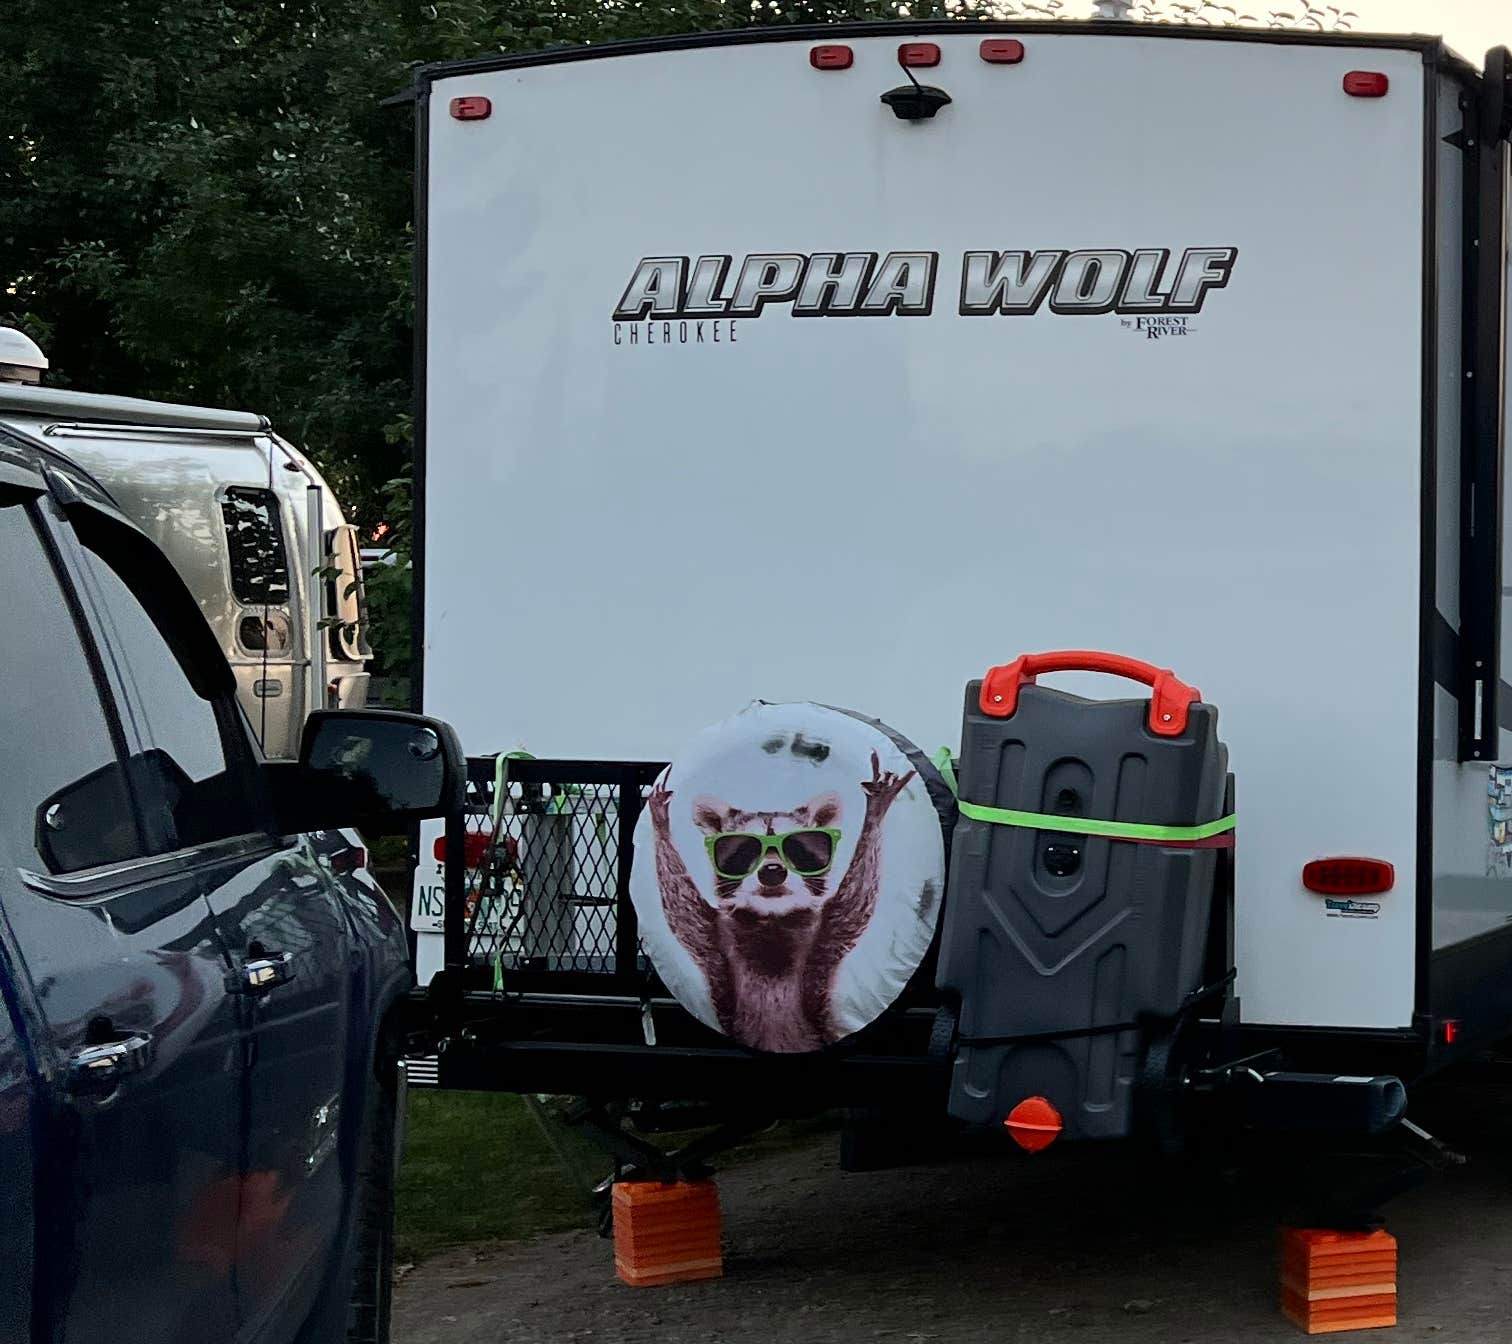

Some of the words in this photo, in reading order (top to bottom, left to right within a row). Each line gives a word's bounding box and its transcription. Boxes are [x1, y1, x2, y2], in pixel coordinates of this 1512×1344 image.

[612, 252, 939, 321] ALPHA
[959, 247, 1238, 316] WOLF
[614, 320, 737, 345] CHEROKEE
[1136, 316, 1188, 330] FOREST
[1147, 326, 1187, 339] RIVER
